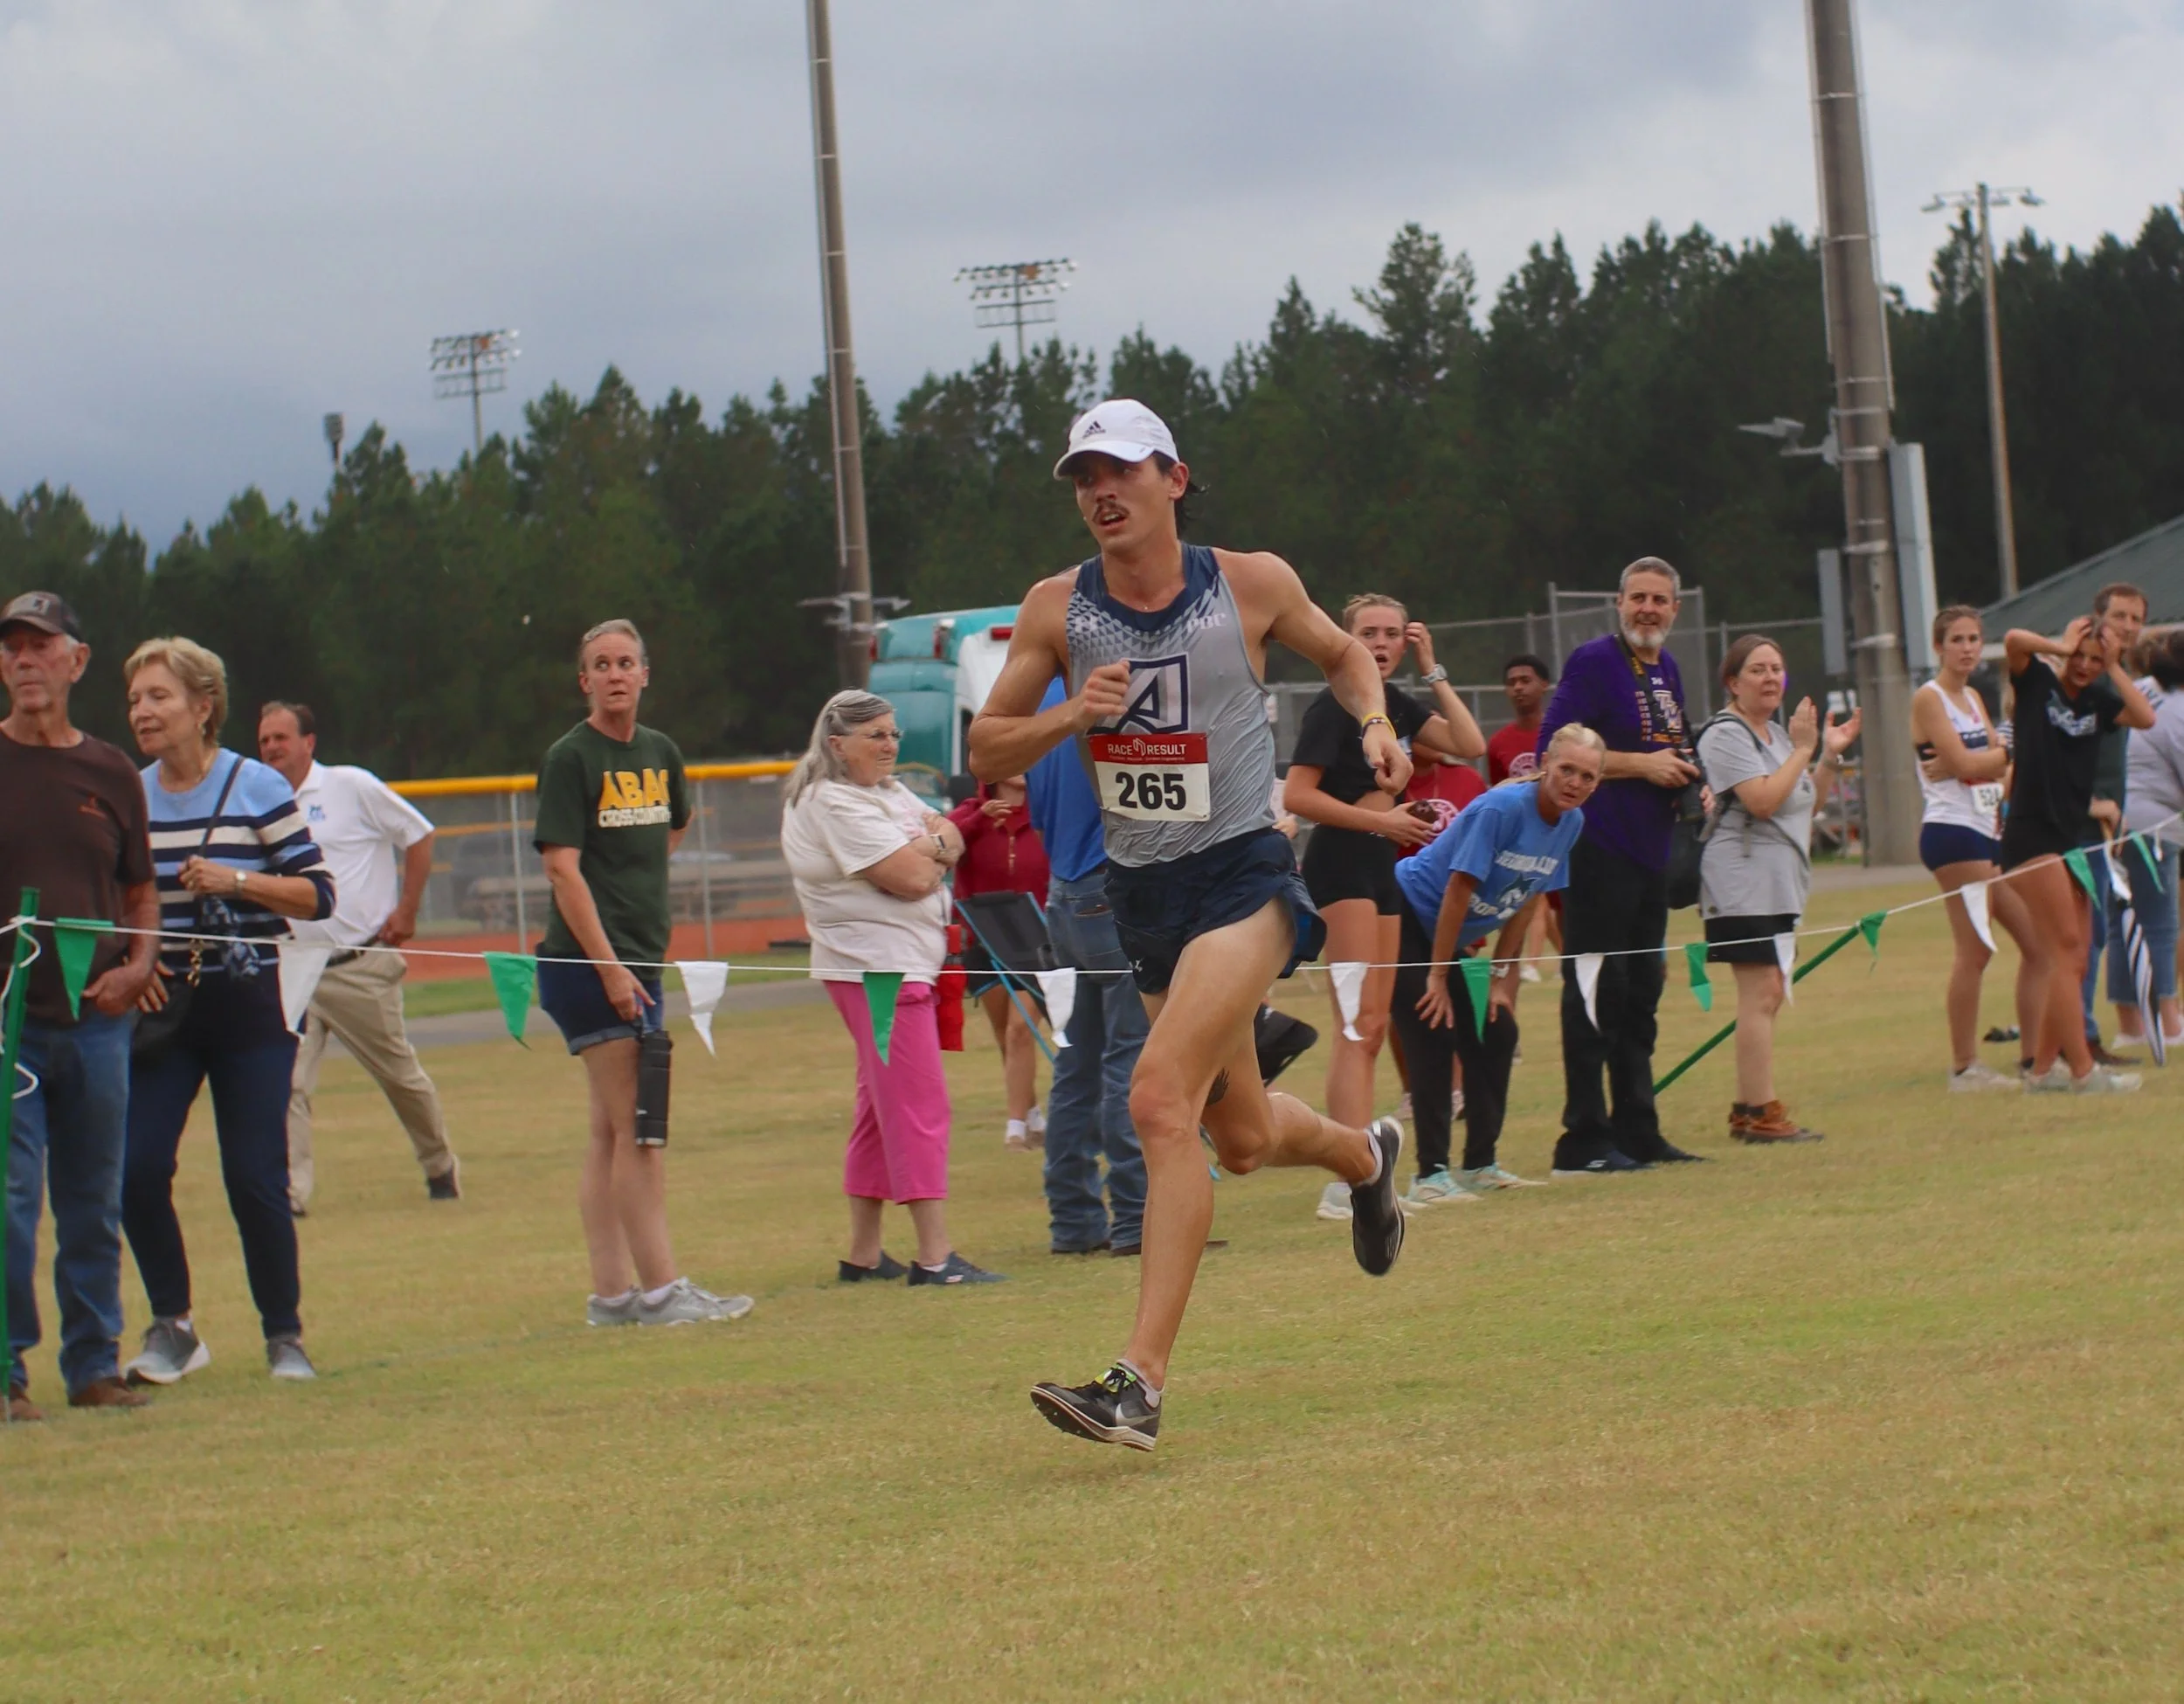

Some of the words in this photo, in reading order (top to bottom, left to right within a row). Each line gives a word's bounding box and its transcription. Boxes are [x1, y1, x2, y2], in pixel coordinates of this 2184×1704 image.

[1108, 744, 1133, 755] RACE
[1146, 744, 1187, 755] RESULT
[1115, 772, 1186, 811] 265
